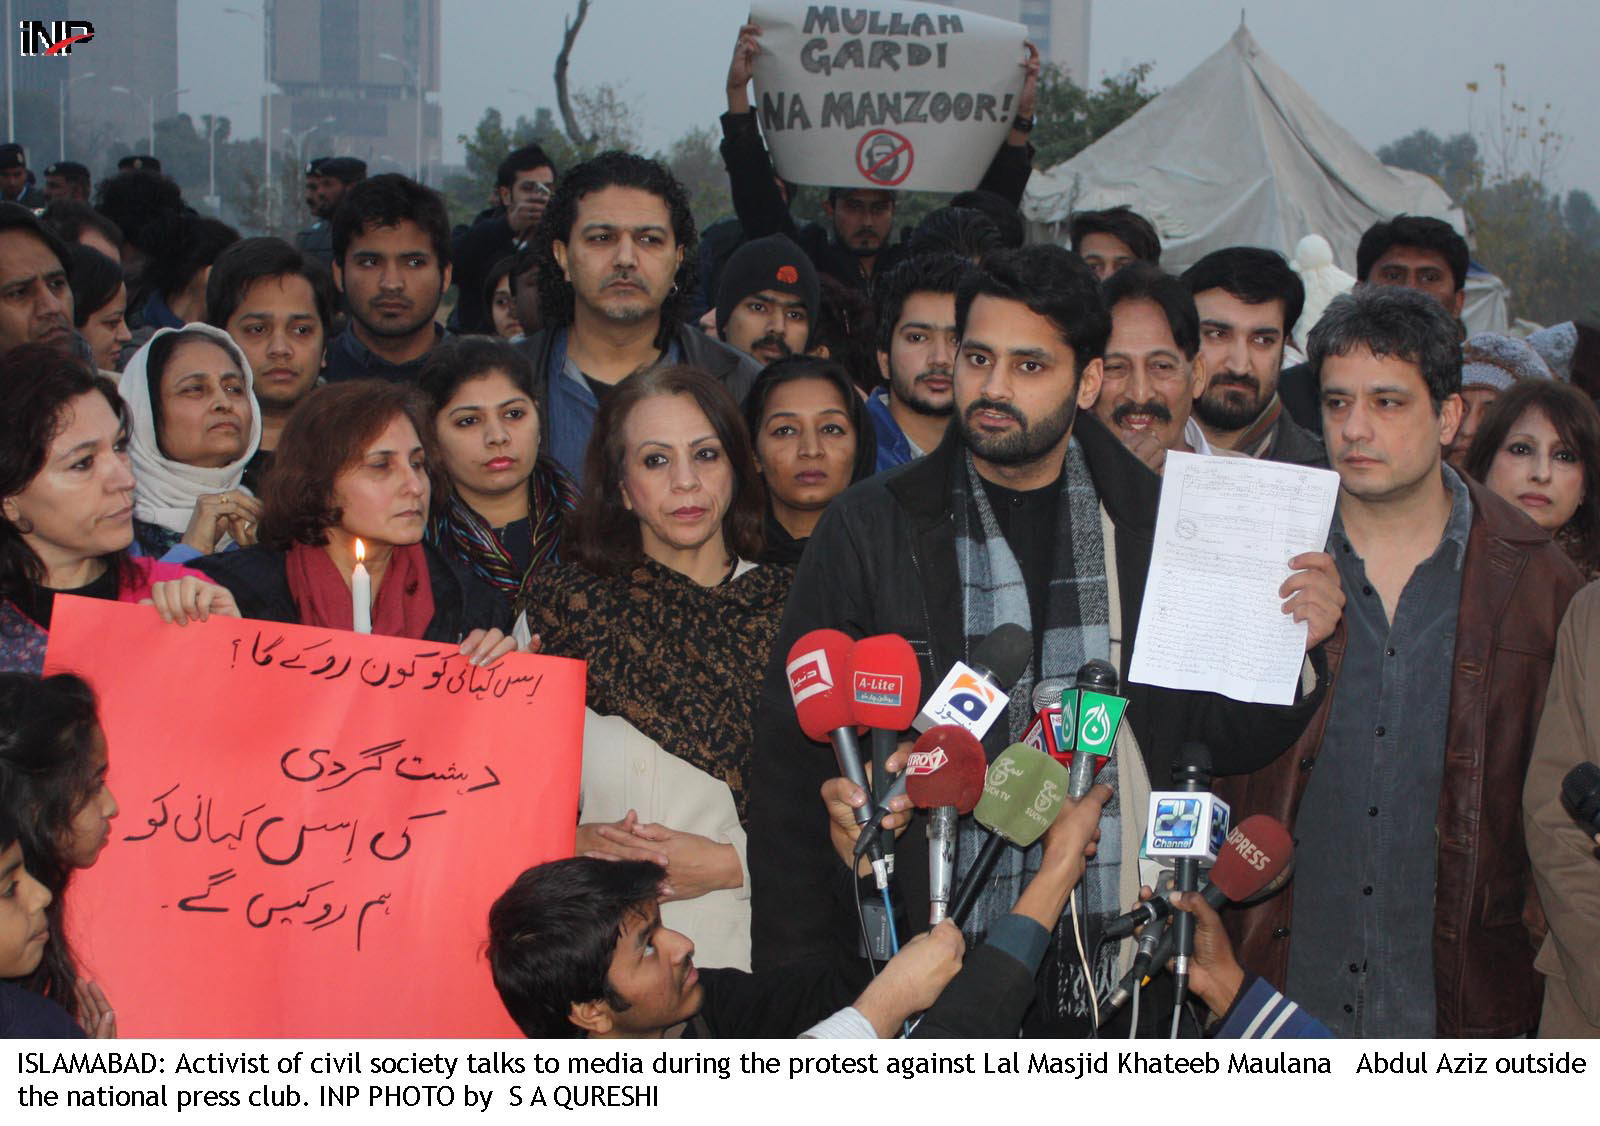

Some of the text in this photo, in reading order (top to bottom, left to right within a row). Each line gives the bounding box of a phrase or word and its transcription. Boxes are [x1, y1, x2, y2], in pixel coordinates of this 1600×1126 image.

[802, 5, 964, 36] MULLAH
[800, 38, 949, 76] GARDI
[762, 89, 1014, 131] NA MANZOOR!
[279, 638, 352, 680] روکے
[361, 651, 440, 688] کون
[422, 652, 461, 690] کو
[858, 676, 896, 691] A-Lite
[280, 739, 501, 795] دہشت گردی
[122, 784, 180, 842] کو
[174, 794, 266, 850] کہانی
[1153, 799, 1201, 837] 24
[370, 809, 447, 861] کی
[1153, 837, 1193, 848] Channel
[246, 880, 348, 932] روکیں
[357, 892, 392, 952] ہم
